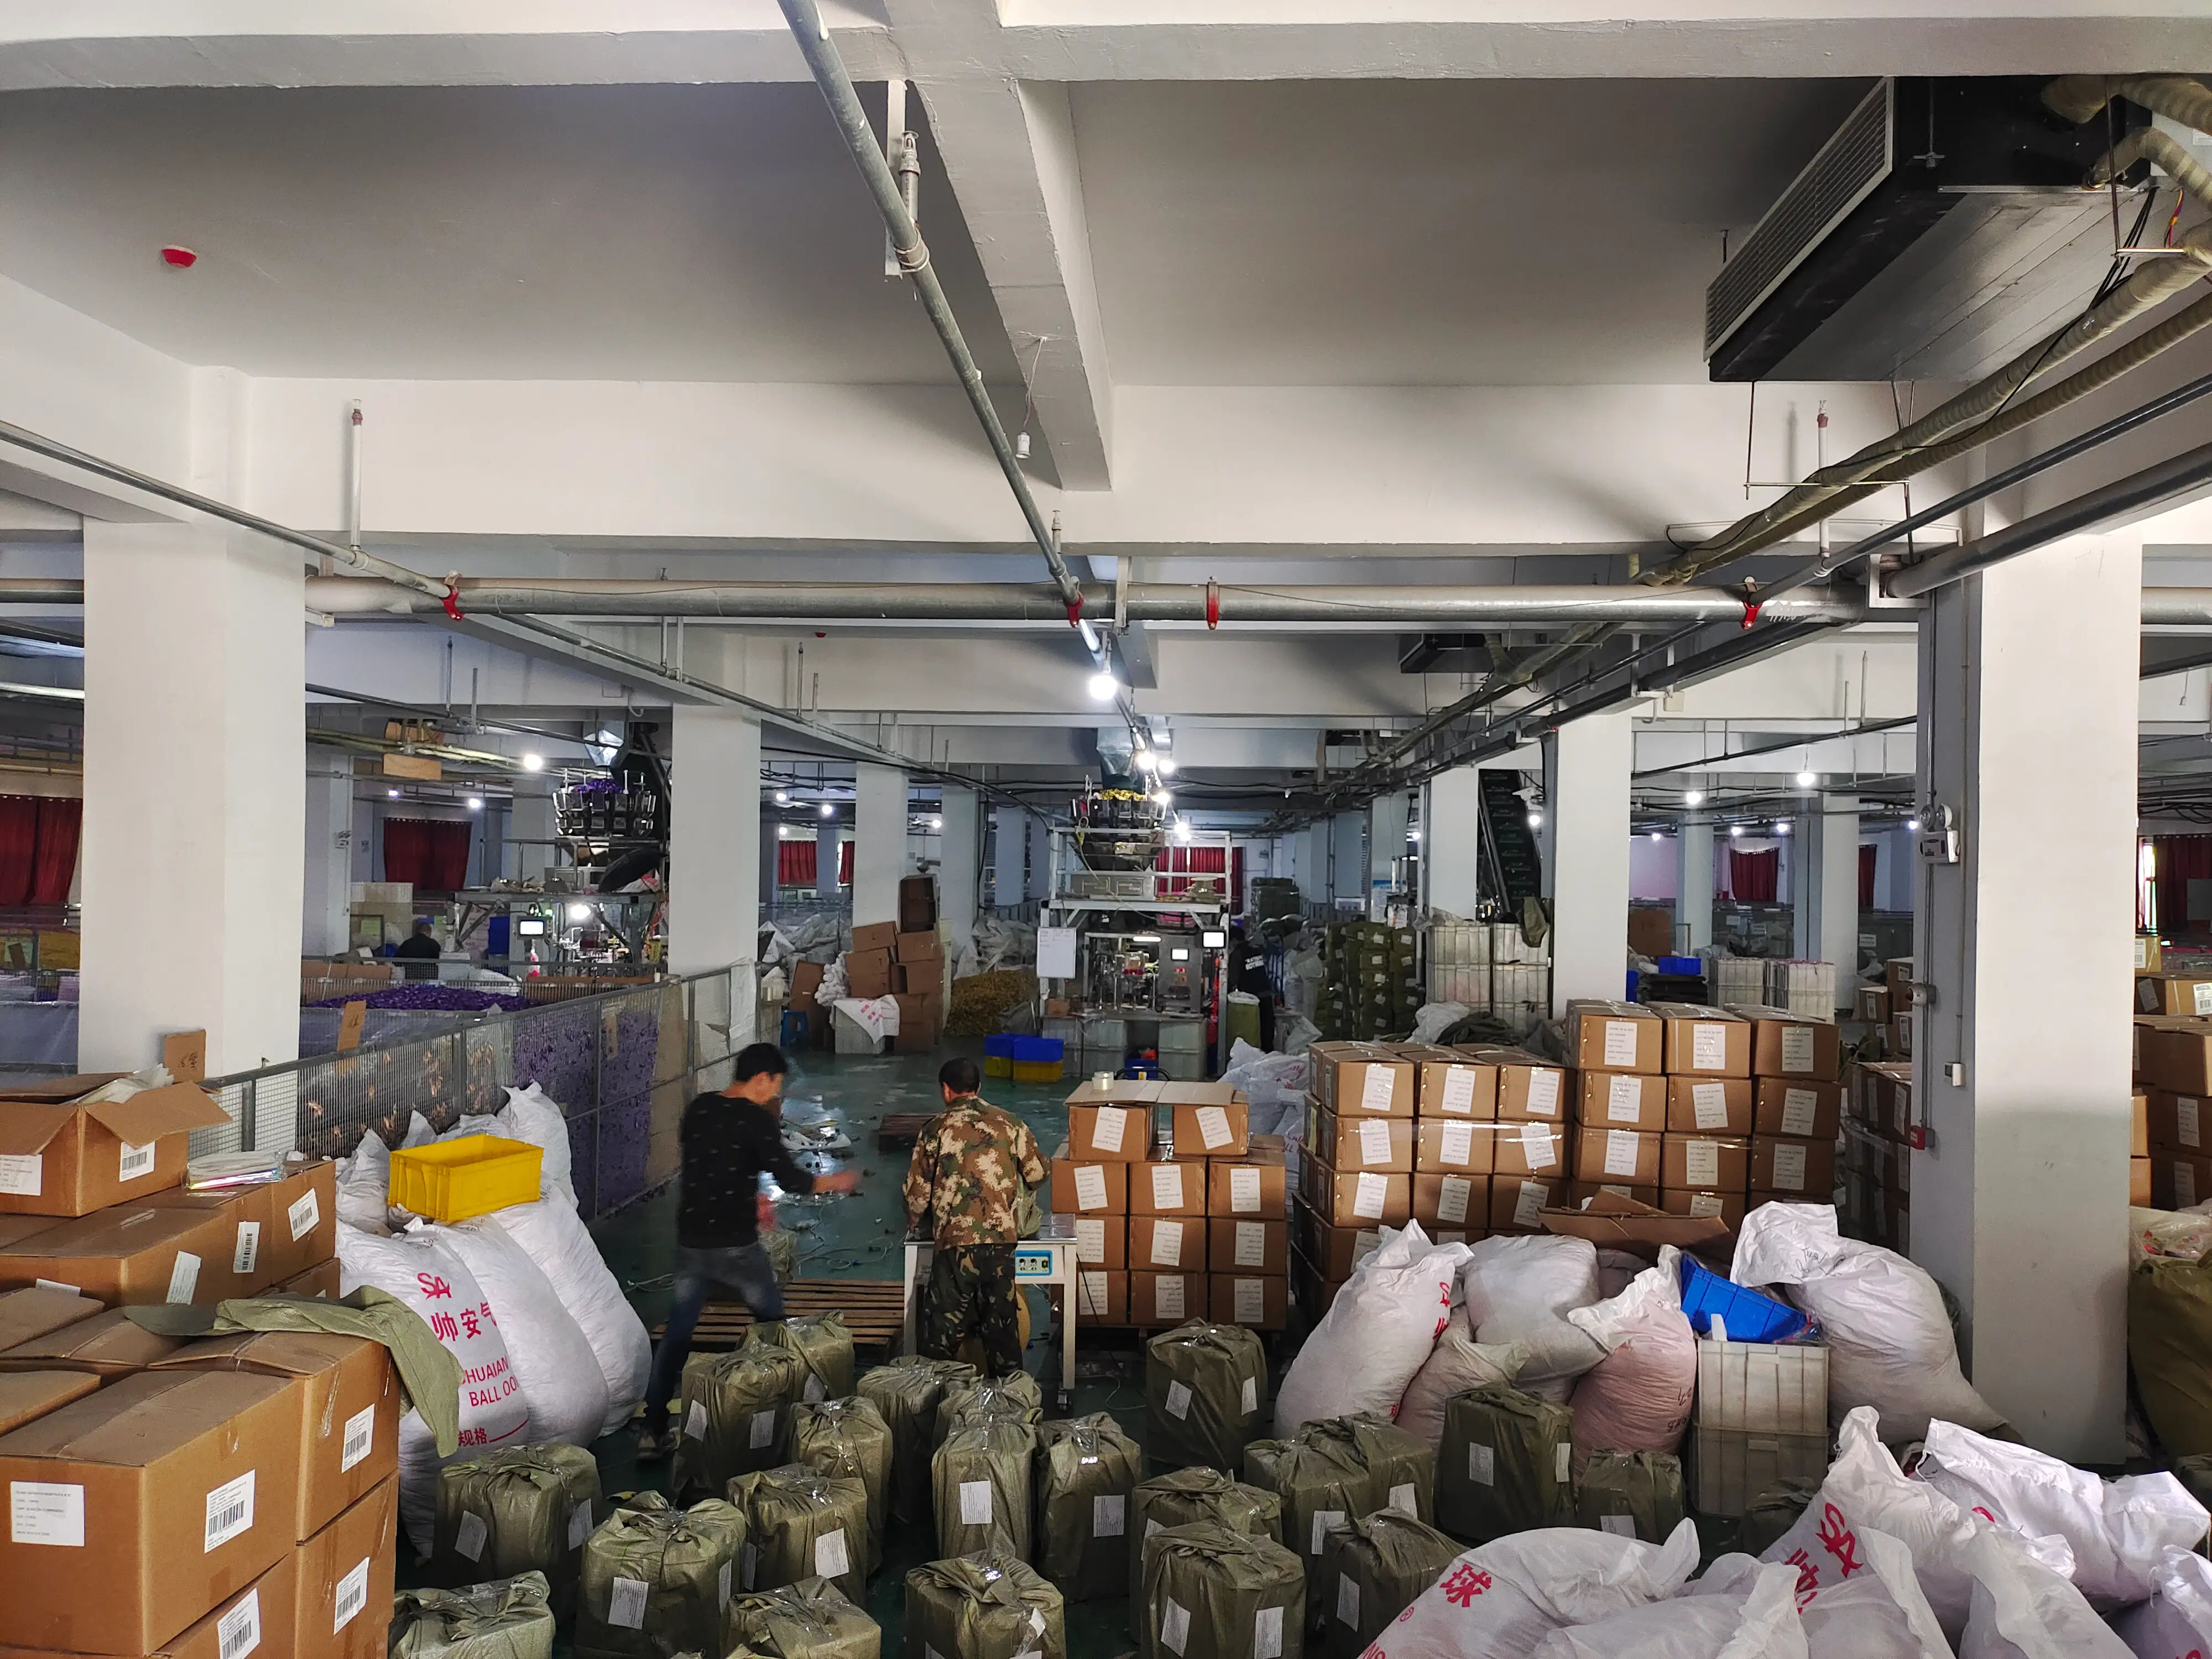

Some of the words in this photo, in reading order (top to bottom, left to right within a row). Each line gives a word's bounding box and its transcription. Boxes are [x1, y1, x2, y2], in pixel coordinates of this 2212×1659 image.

[418, 1272, 452, 1300] SA
[468, 1386, 502, 1407] BALL
[458, 1427, 487, 1447] 规格
[1815, 1501, 1864, 1578] SA
[1439, 1563, 1492, 1608] 球
